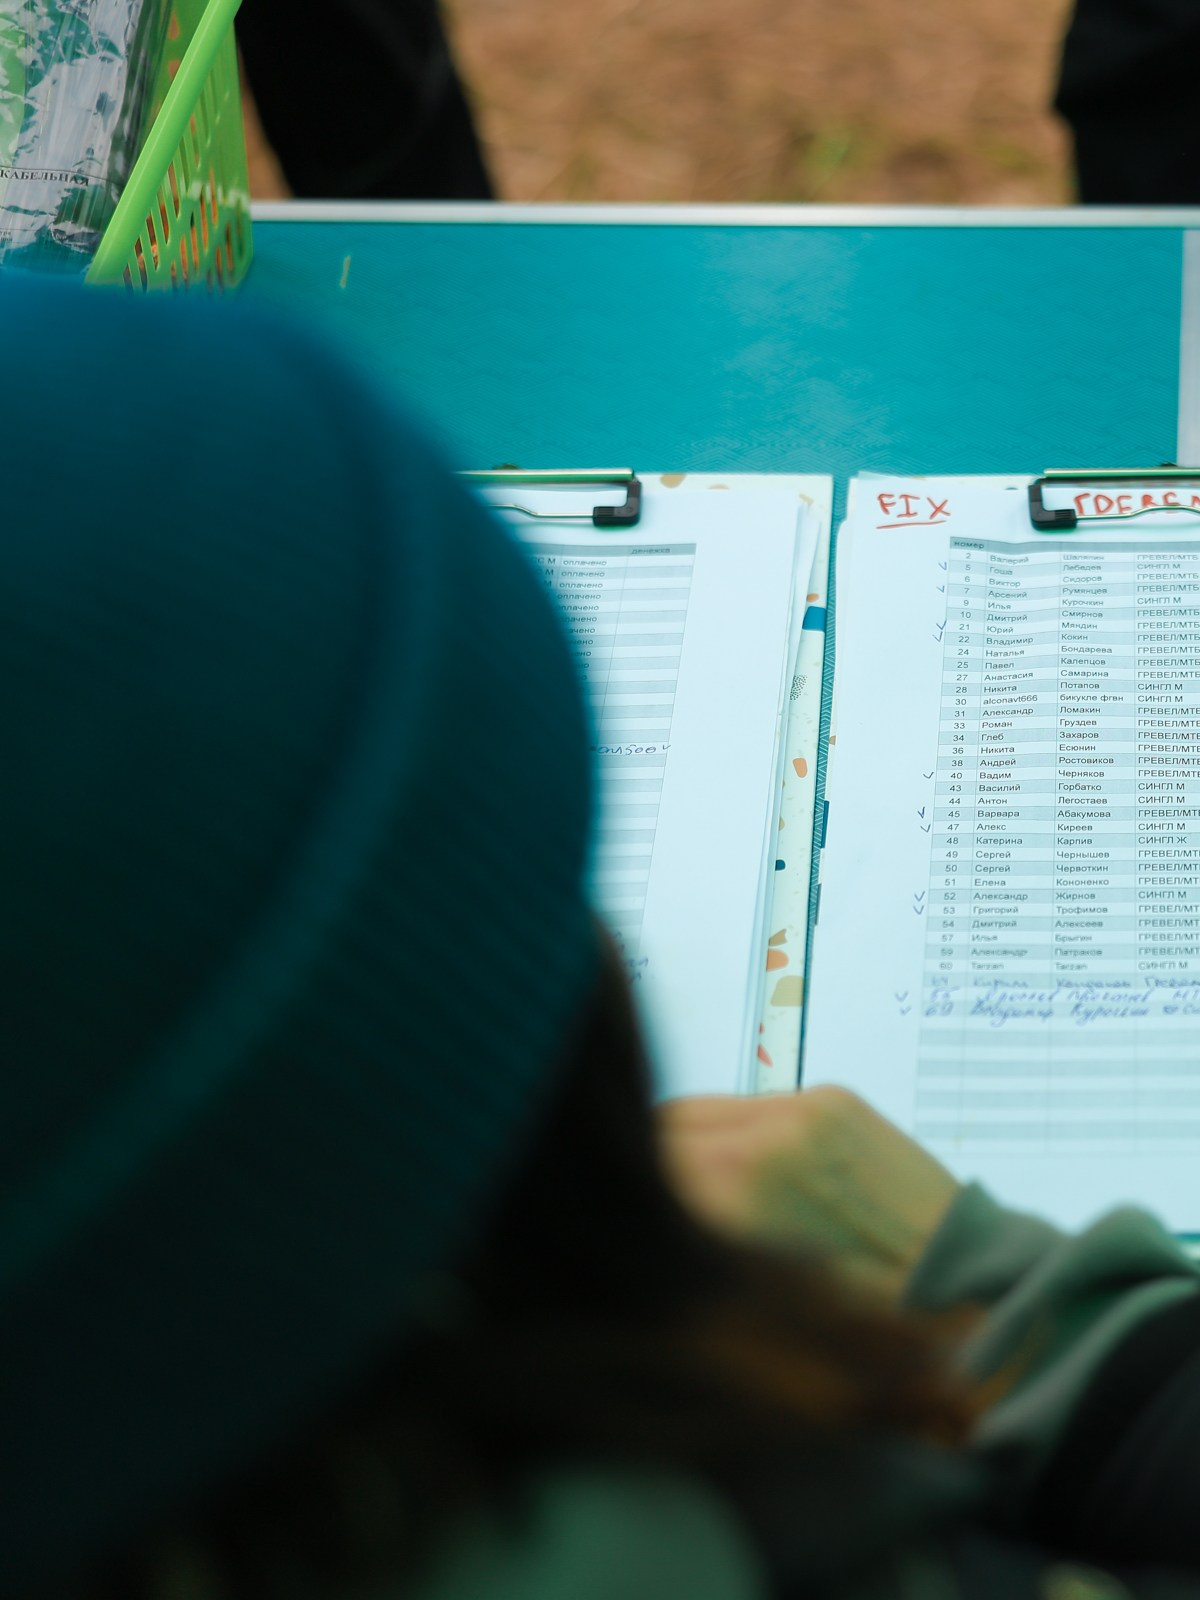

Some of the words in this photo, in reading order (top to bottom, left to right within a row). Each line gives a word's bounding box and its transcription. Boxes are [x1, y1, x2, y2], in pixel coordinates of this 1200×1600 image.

[877, 493, 951, 520] FIX
[954, 541, 984, 549] номер
[986, 638, 1033, 646] Владимир
[1061, 646, 1112, 654] Бондарева
[1138, 646, 1200, 654] ГРЕВЕЛ/МТБ
[1061, 658, 1106, 666] Калепцов
[984, 673, 1033, 681] Анастасия
[1060, 719, 1096, 727] Груздев
[982, 733, 1004, 741] Глеб
[1060, 731, 1099, 739] Захаров
[980, 759, 1016, 767] Андрей
[980, 772, 1011, 780] Вадим
[1059, 770, 1104, 778] Черняков
[1059, 783, 1101, 792] Горбатко
[978, 810, 1019, 818] Варвара
[1057, 810, 1110, 819] Абакумова
[1058, 824, 1092, 832] Киреев
[977, 837, 1022, 846] Катерина
[1138, 836, 1173, 844] СИНГЛ
[1177, 836, 1187, 844] Ж
[976, 851, 1011, 860] Сергей
[1057, 851, 1109, 860] Чернышев
[945, 864, 957, 872] 50
[975, 864, 1010, 874] Сергей
[1057, 865, 1108, 874] Червоткин
